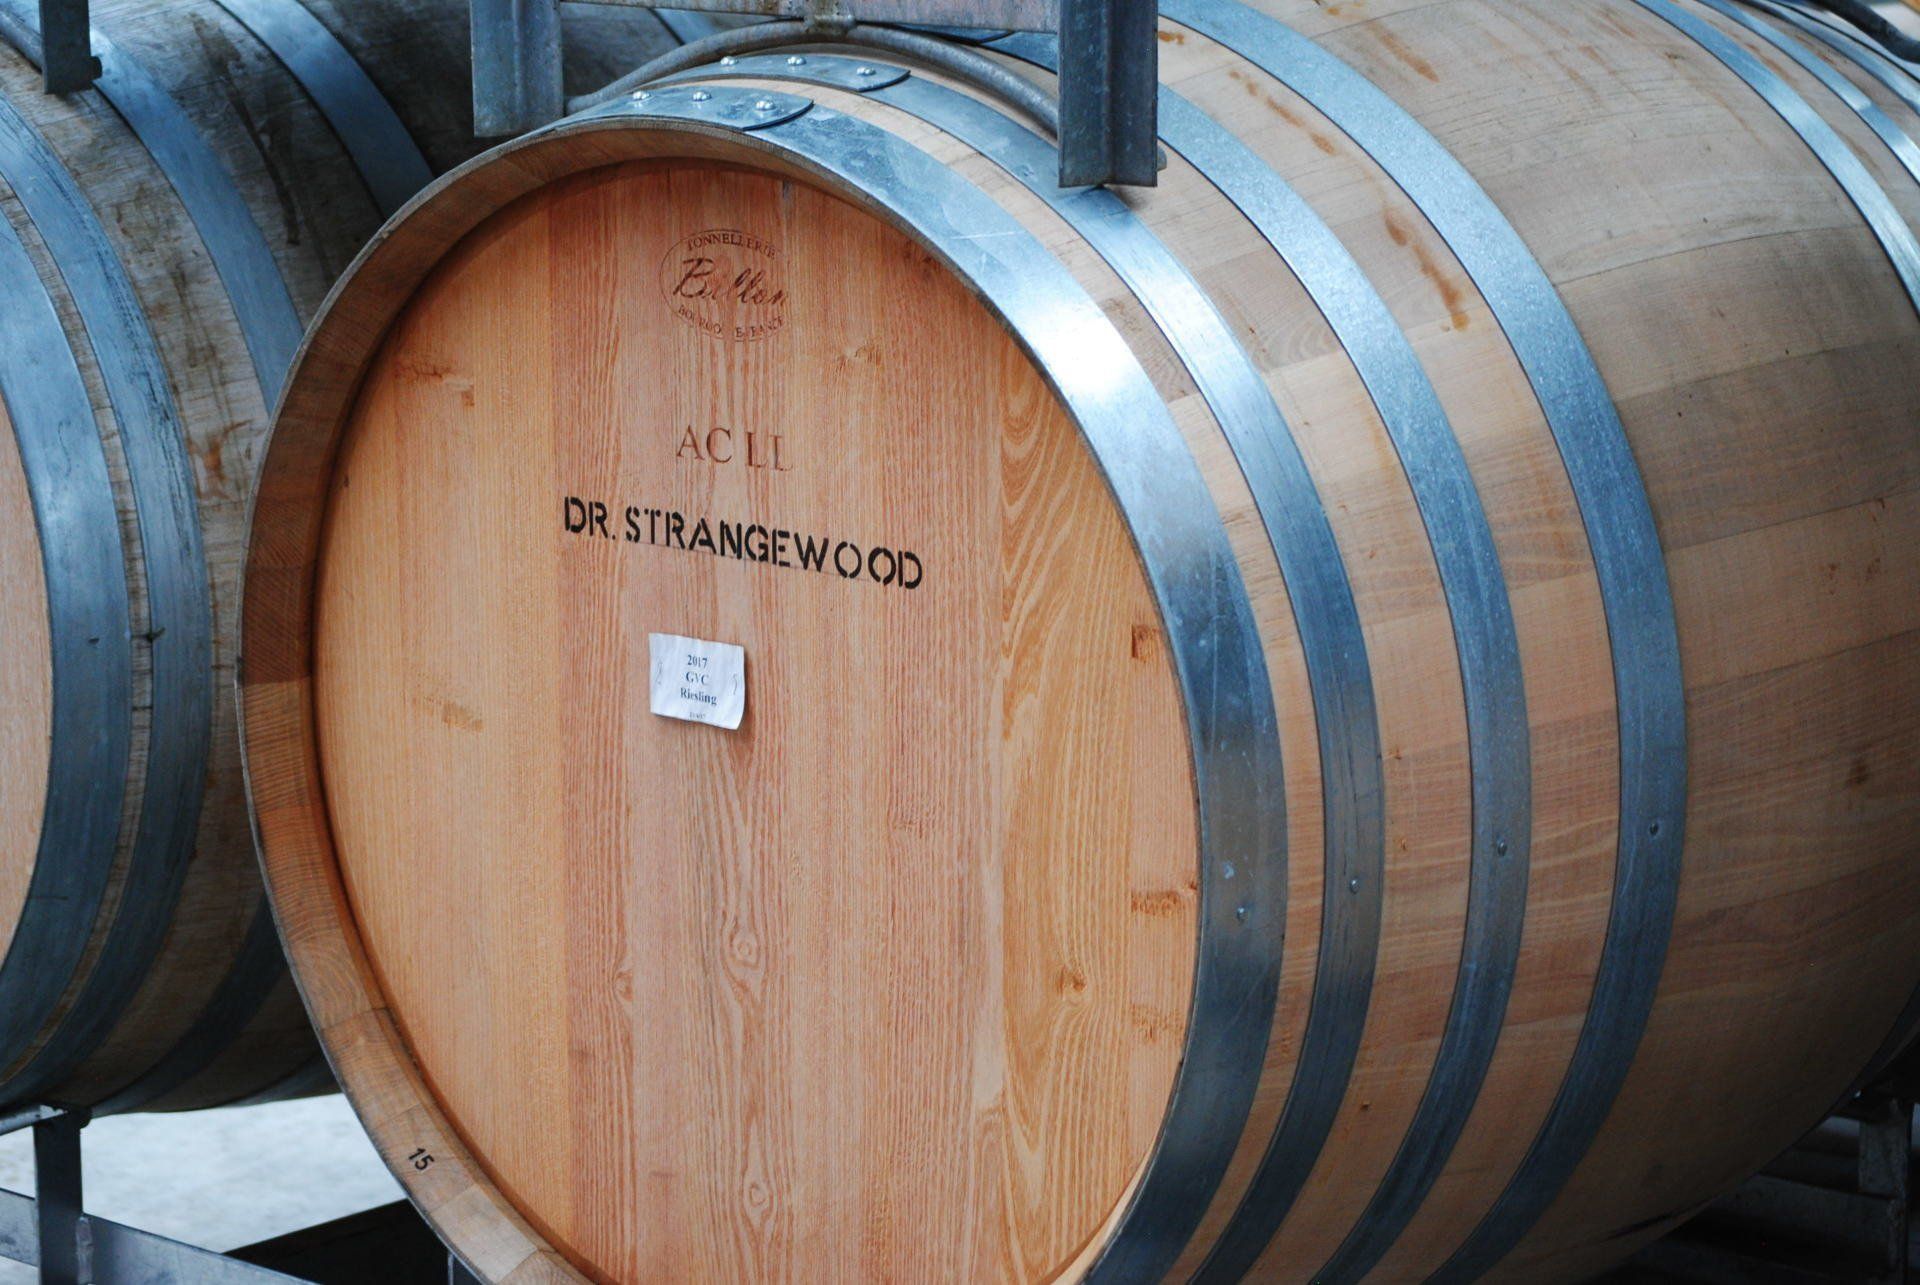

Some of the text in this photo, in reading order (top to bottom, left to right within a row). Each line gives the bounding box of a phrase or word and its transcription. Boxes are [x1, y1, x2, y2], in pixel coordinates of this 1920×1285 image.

[687, 232, 777, 260] TONNELLERIE
[563, 496, 923, 590] DR. STRANGEWOOD
[687, 654, 708, 669] 2017
[680, 687, 717, 706] Riesling
[408, 1147, 435, 1171] 15
